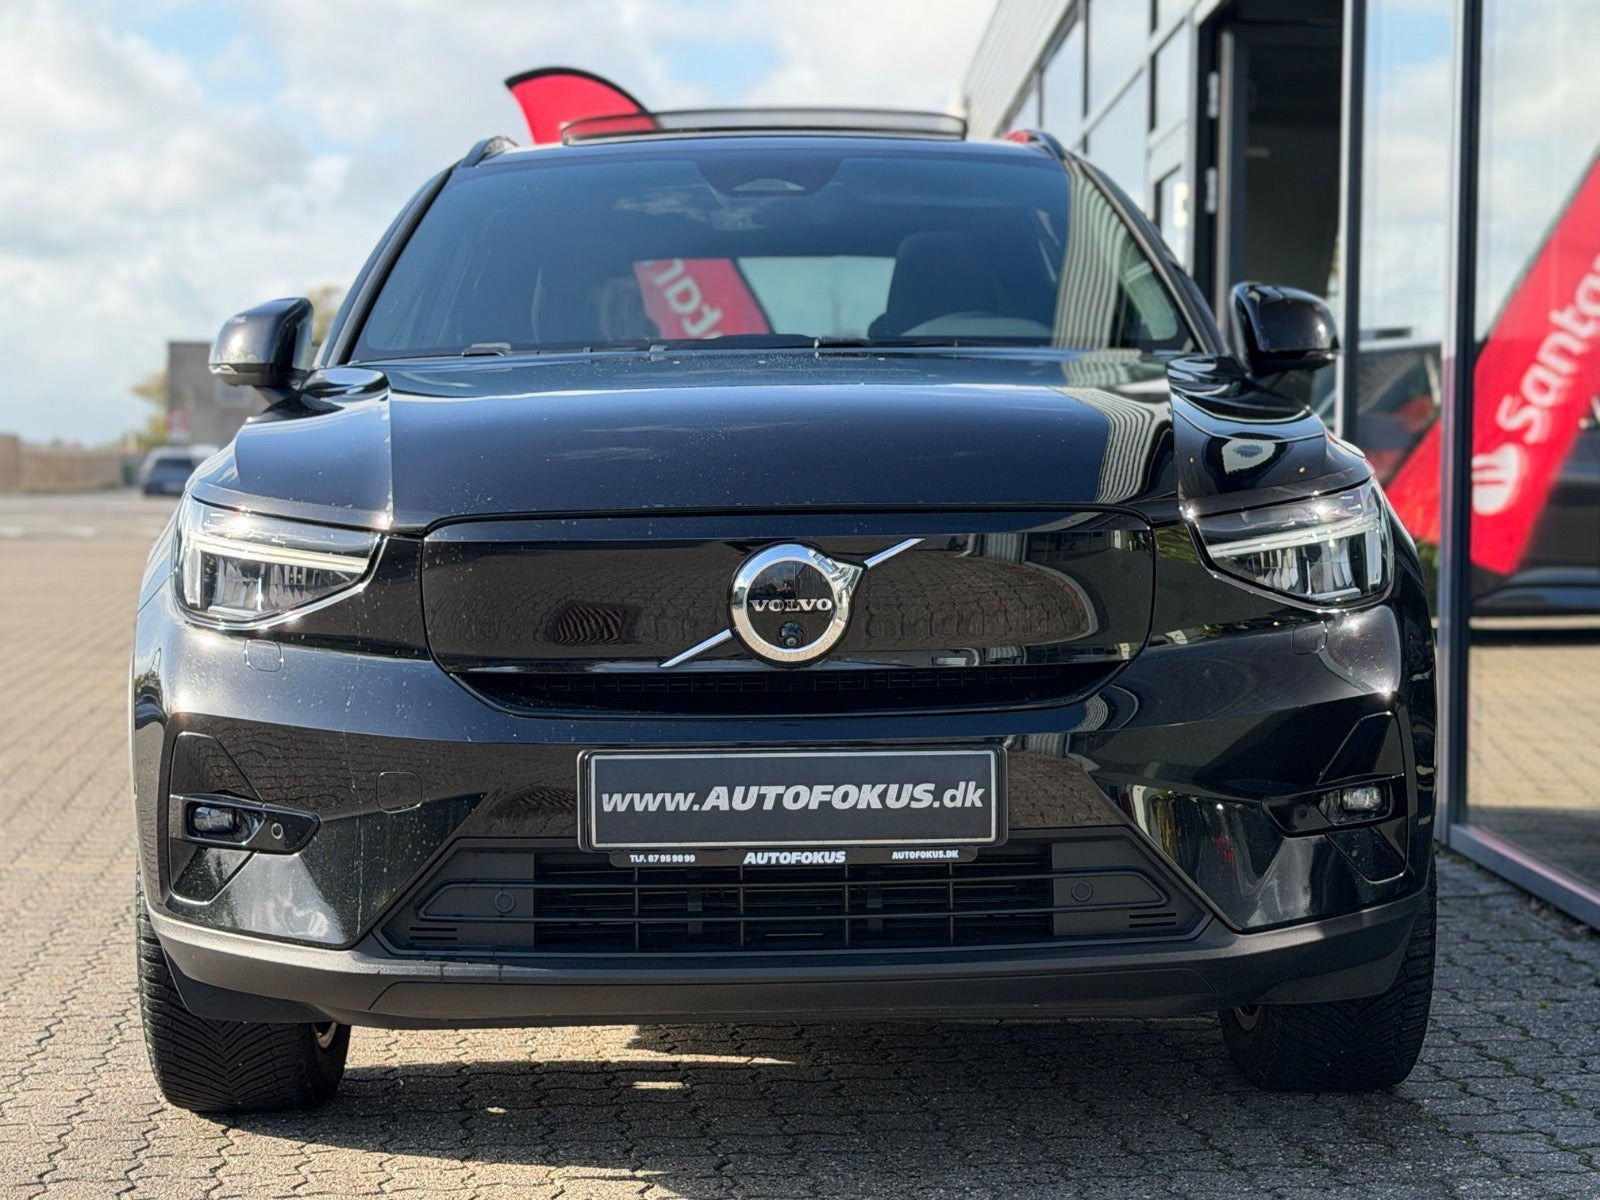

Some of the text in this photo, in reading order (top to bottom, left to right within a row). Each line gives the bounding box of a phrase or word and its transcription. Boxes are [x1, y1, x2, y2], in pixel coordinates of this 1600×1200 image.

[1496, 254, 1600, 445] Santa
[749, 598, 833, 612] VOLVO
[601, 781, 985, 812] www.AUTOFOKUS.dk
[629, 854, 647, 863] TLF.
[743, 851, 846, 865] AUTOFOKUS
[891, 849, 959, 860] AUTOFOKUS.DK
